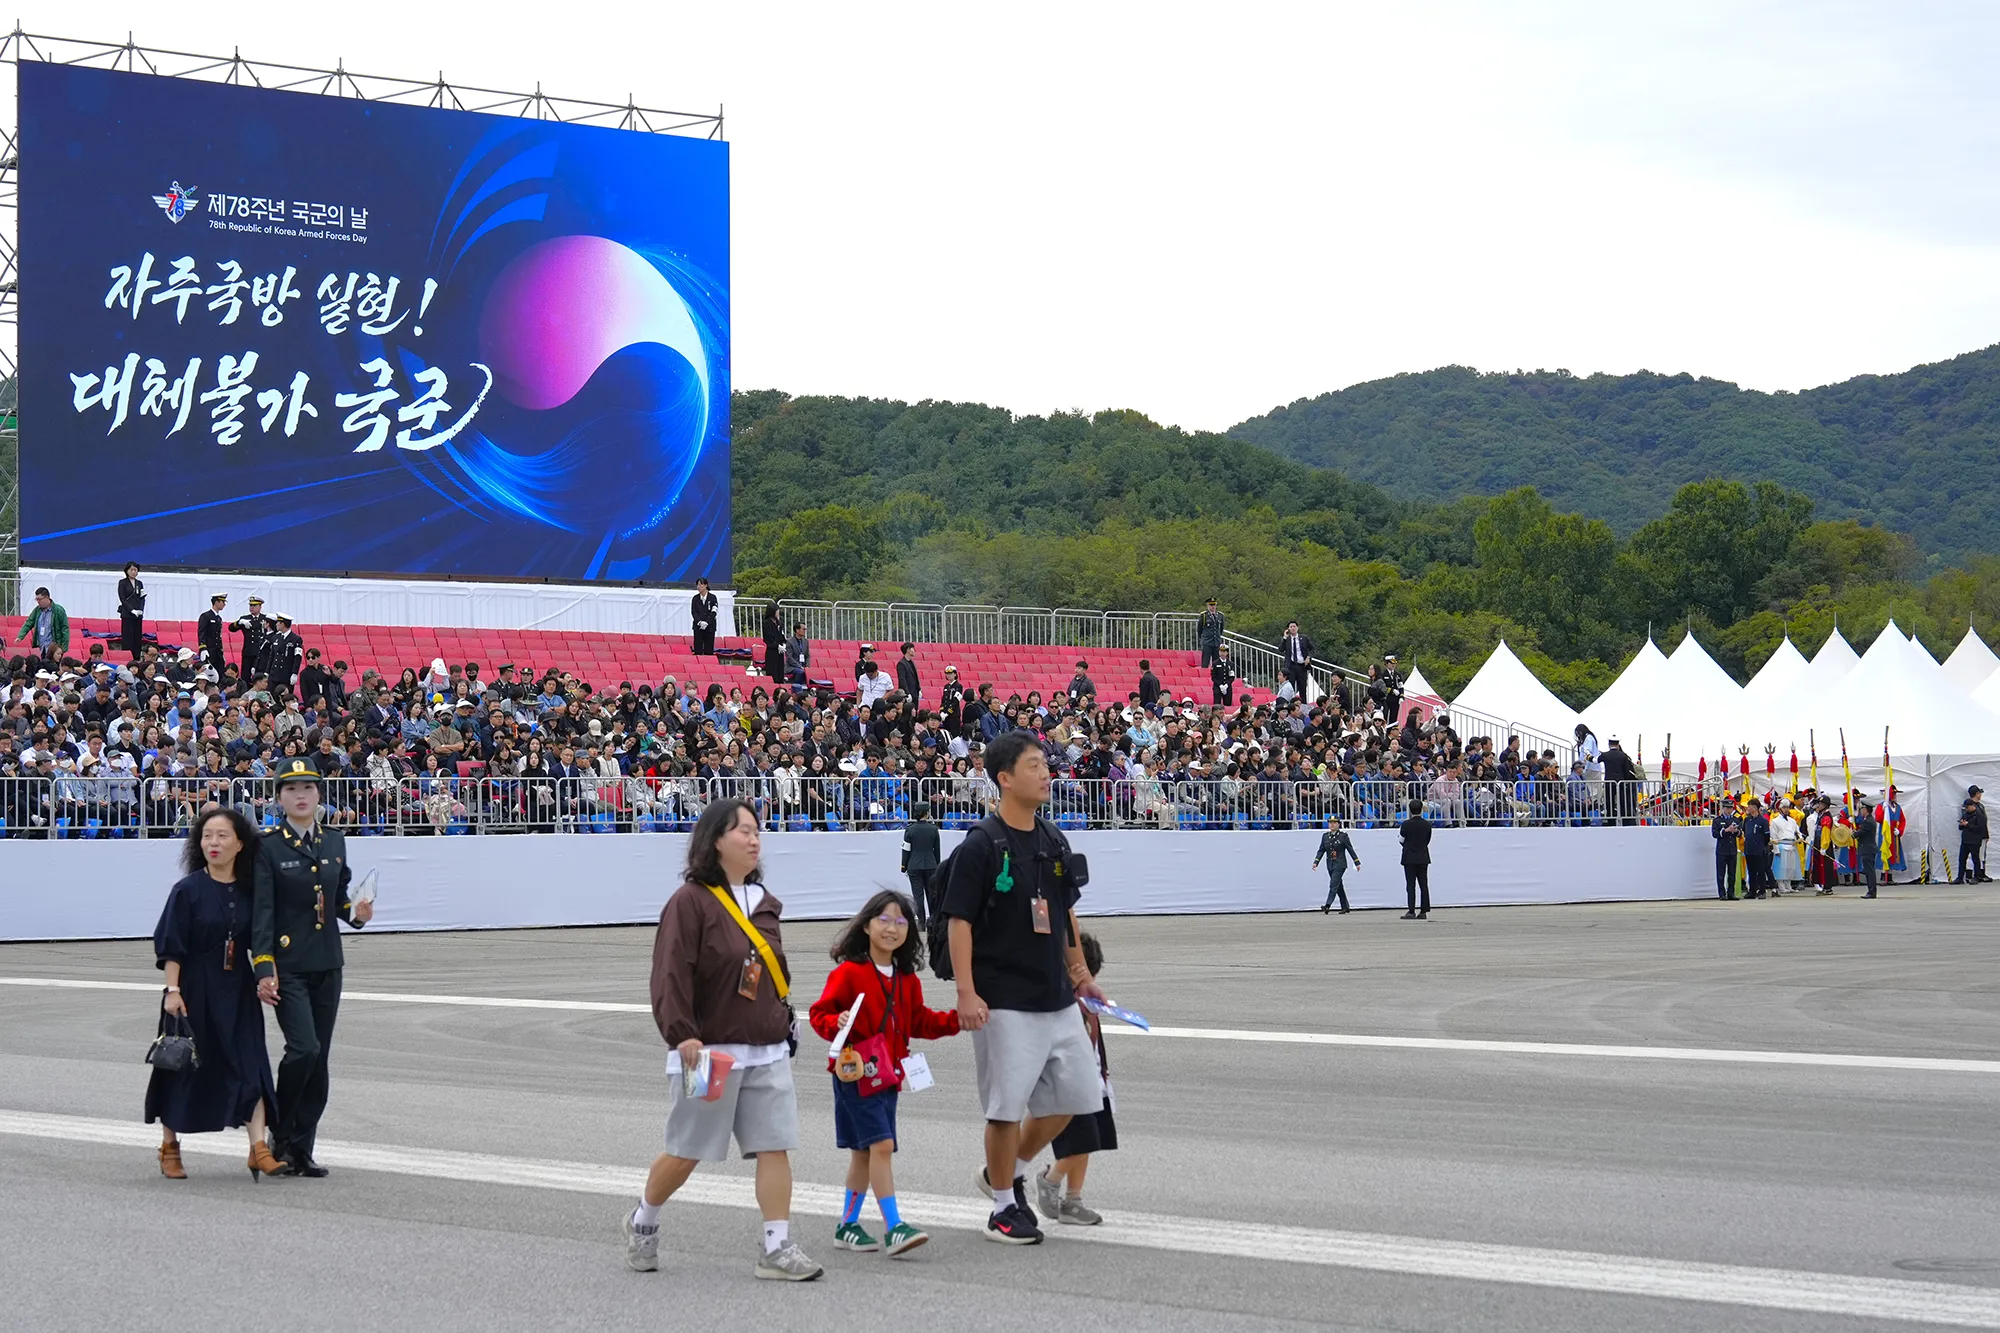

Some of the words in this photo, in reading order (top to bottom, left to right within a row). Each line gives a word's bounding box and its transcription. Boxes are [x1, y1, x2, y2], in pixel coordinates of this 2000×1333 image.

[208, 193, 285, 222] 제78주년
[292, 202, 344, 228] 국군의
[351, 207, 369, 230] 날
[208, 219, 227, 230] 78th
[228, 221, 262, 233] Republic
[263, 225, 272, 234] of
[274, 226, 297, 236] Korea
[298, 228, 324, 239] Armed
[325, 231, 351, 241] Forces
[352, 233, 368, 244] Day
[105, 252, 301, 327] 자주국방
[69, 351, 319, 446] 대체불가
[335, 358, 493, 453] 국군
